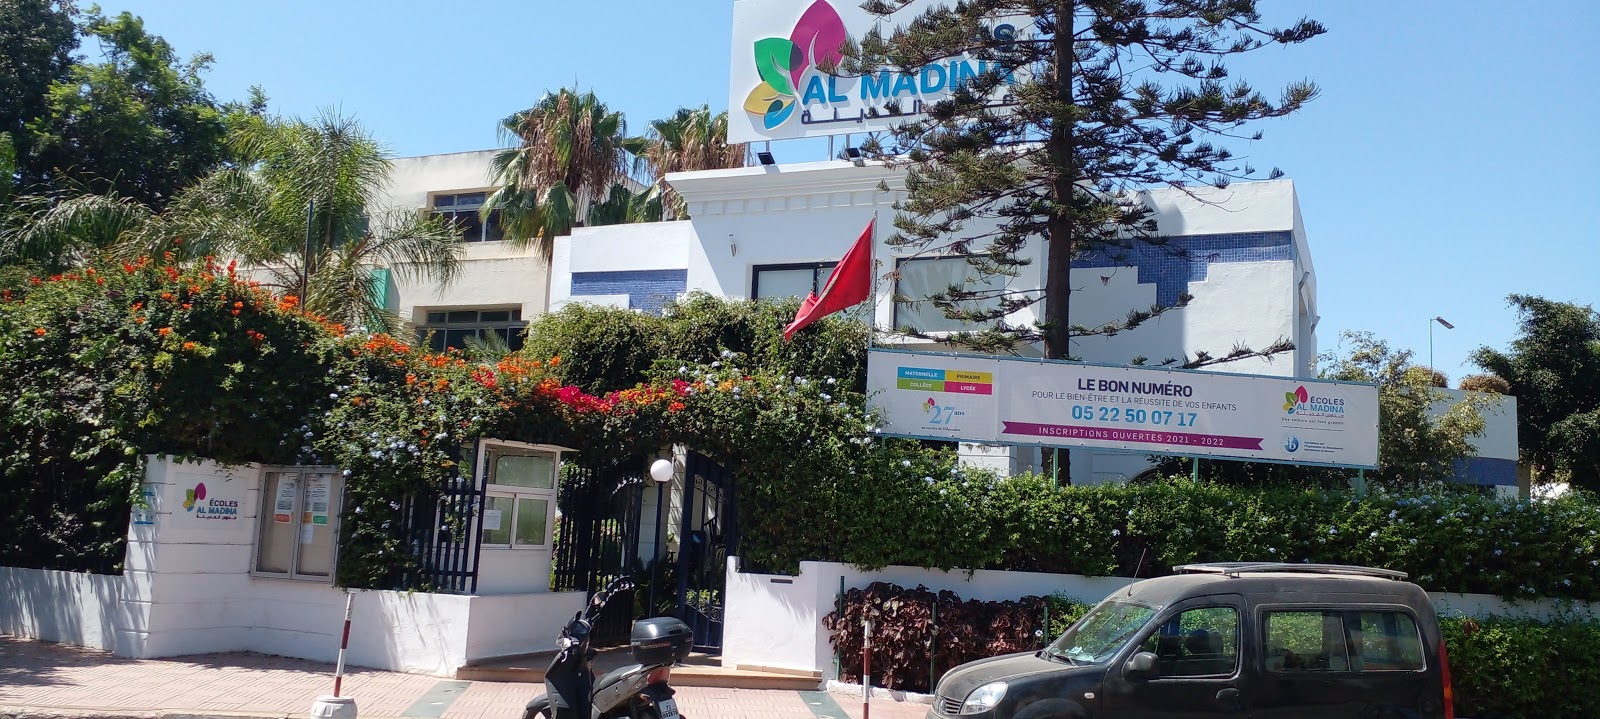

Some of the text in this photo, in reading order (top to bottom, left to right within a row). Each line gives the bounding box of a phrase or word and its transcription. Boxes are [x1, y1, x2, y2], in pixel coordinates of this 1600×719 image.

[802, 75, 848, 105] AL
[1077, 378, 1193, 397] LE BON NUMÉRO
[1032, 390, 1237, 411] POUR LE BIEN-ÊTRE ET LA RÉUSSITE DE VOS ENFANTS
[1296, 403, 1344, 413] AL MADINA
[1310, 396, 1345, 406] ÉCOLES
[930, 406, 955, 424] 27
[1071, 404, 1198, 427] 05 22 50 07 17
[1038, 426, 1109, 439] INSCRIPTIONS
[1112, 430, 1163, 442] OUVERTES
[1166, 434, 1189, 444] 2021
[1201, 436, 1225, 446] 2022
[196, 506, 237, 515] AL MADINA
[209, 498, 239, 507] ÉCOLES
